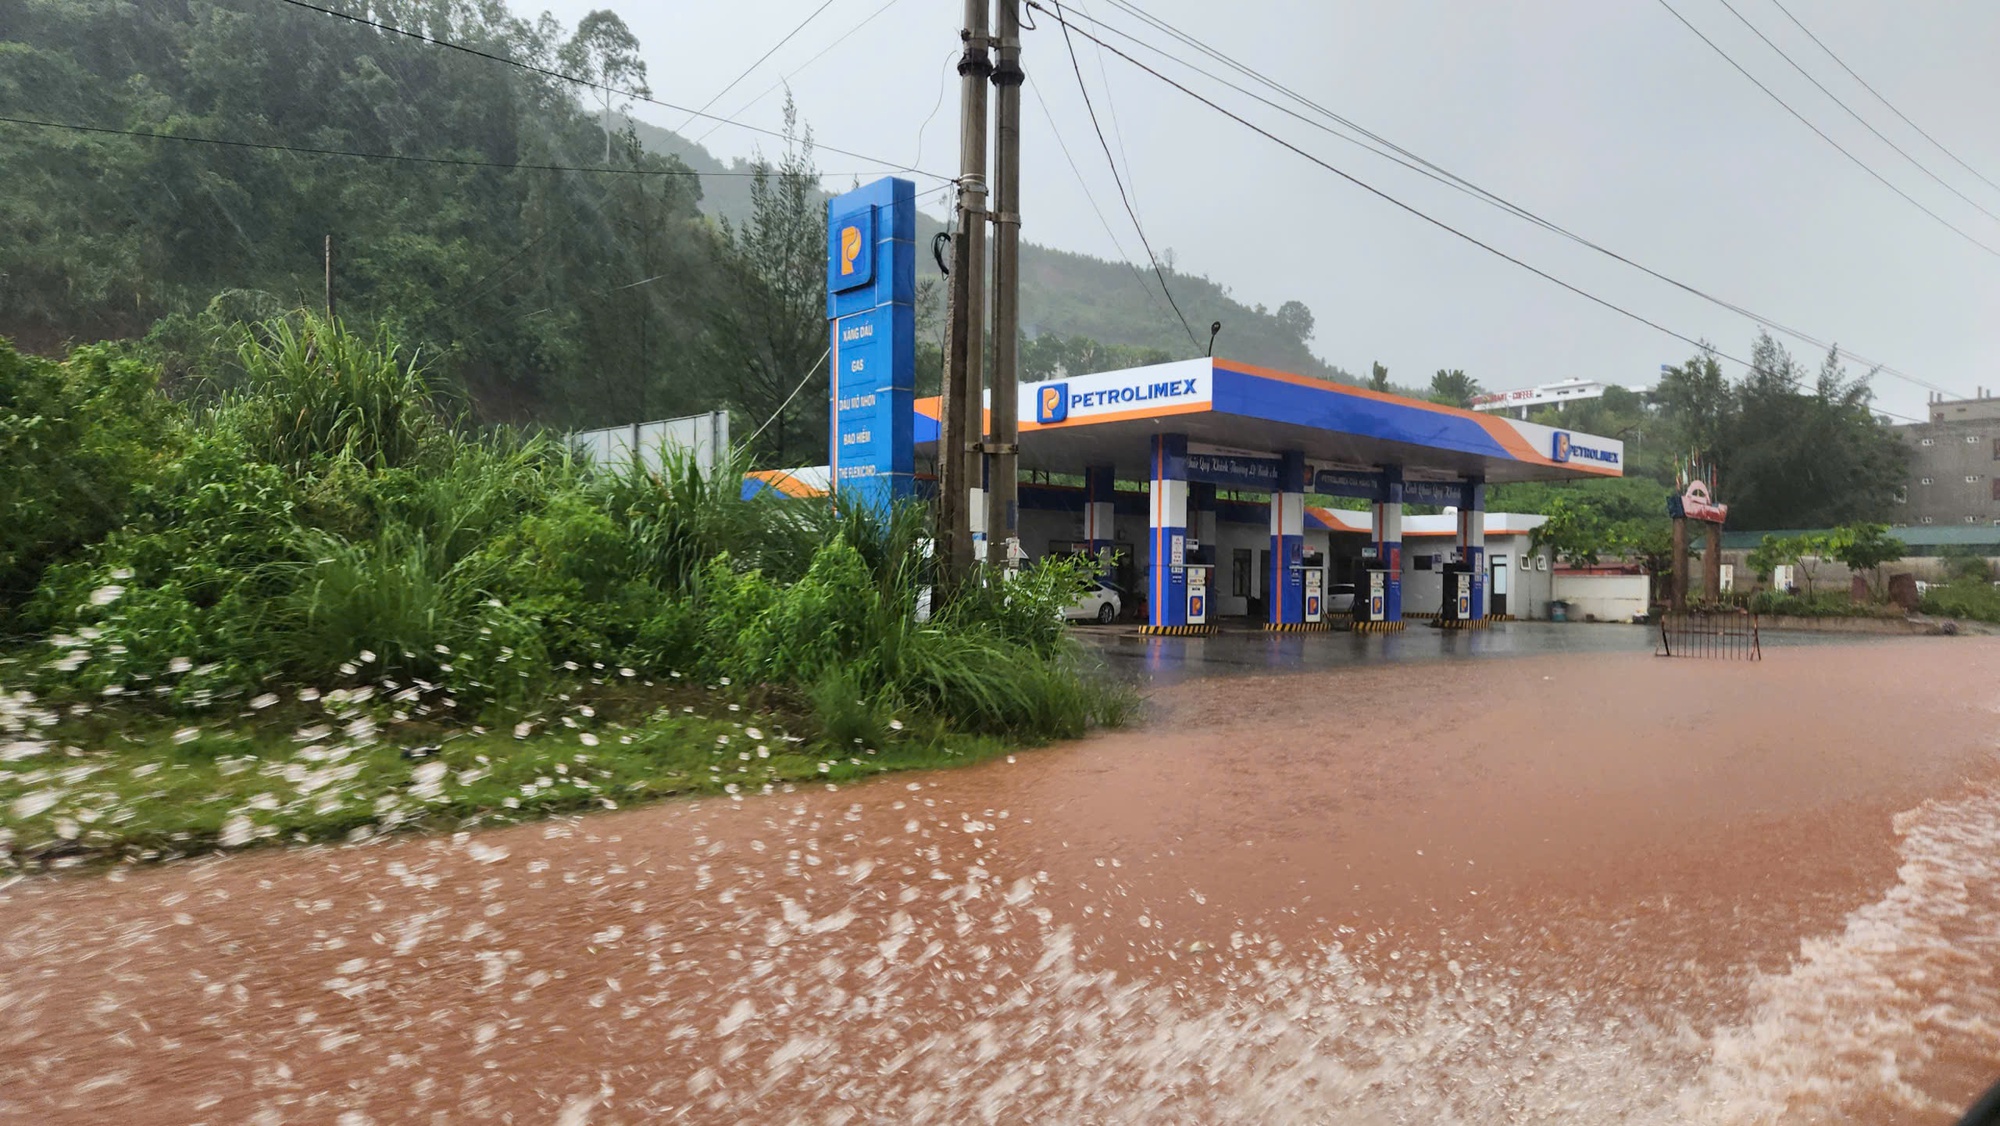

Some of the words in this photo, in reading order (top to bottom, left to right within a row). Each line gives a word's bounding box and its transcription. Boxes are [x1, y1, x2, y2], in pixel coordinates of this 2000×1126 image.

[851, 359, 864, 373] GAS
[1071, 378, 1197, 409] PETROLIMEX
[1569, 445, 1619, 464] PETROLIMEX
